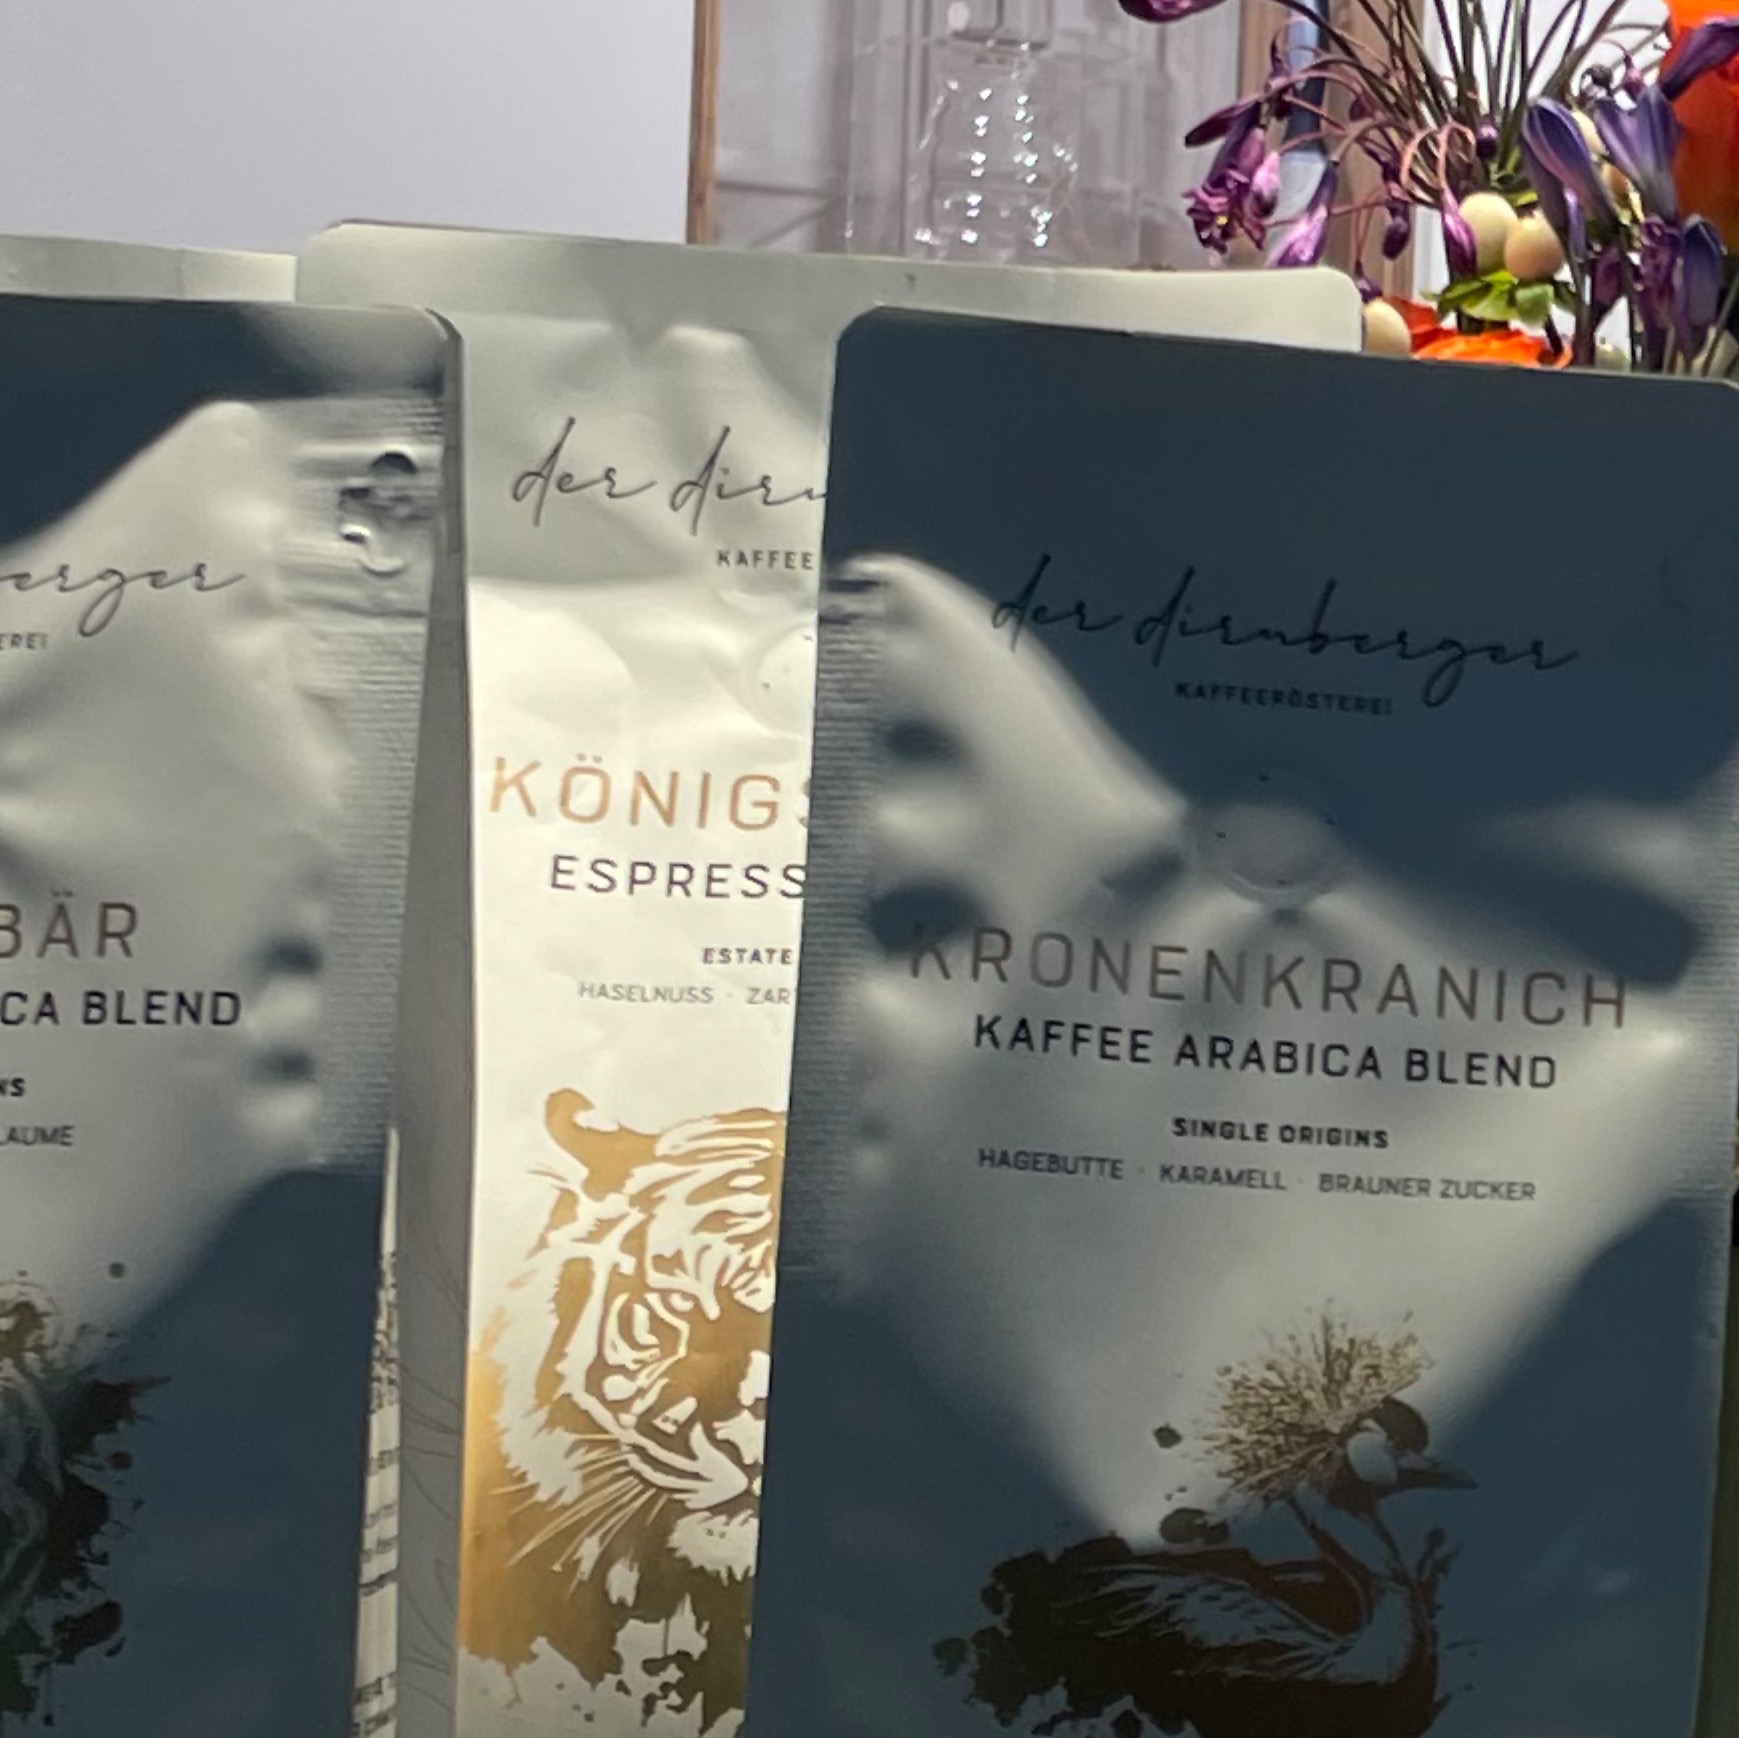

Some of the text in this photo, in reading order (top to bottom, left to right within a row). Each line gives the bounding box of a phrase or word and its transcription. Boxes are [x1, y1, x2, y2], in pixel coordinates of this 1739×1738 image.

[512, 416, 657, 527] der
[717, 549, 815, 571] KAFFEE
[991, 552, 1579, 708] der dirnberger
[0, 888, 139, 959] BÄR
[578, 981, 715, 1004] HASELNUSS
[909, 921, 1628, 1029] KRONENKRANICH
[82, 990, 242, 1027] BLEND
[973, 1013, 1559, 1090] KAFFEE ARABICA BLEND
[1171, 1116, 1390, 1150] SINGLE ORIGINS
[978, 1146, 1537, 1203] HAGEBUTTE KARAMELL BRAUNER ZUCKER
